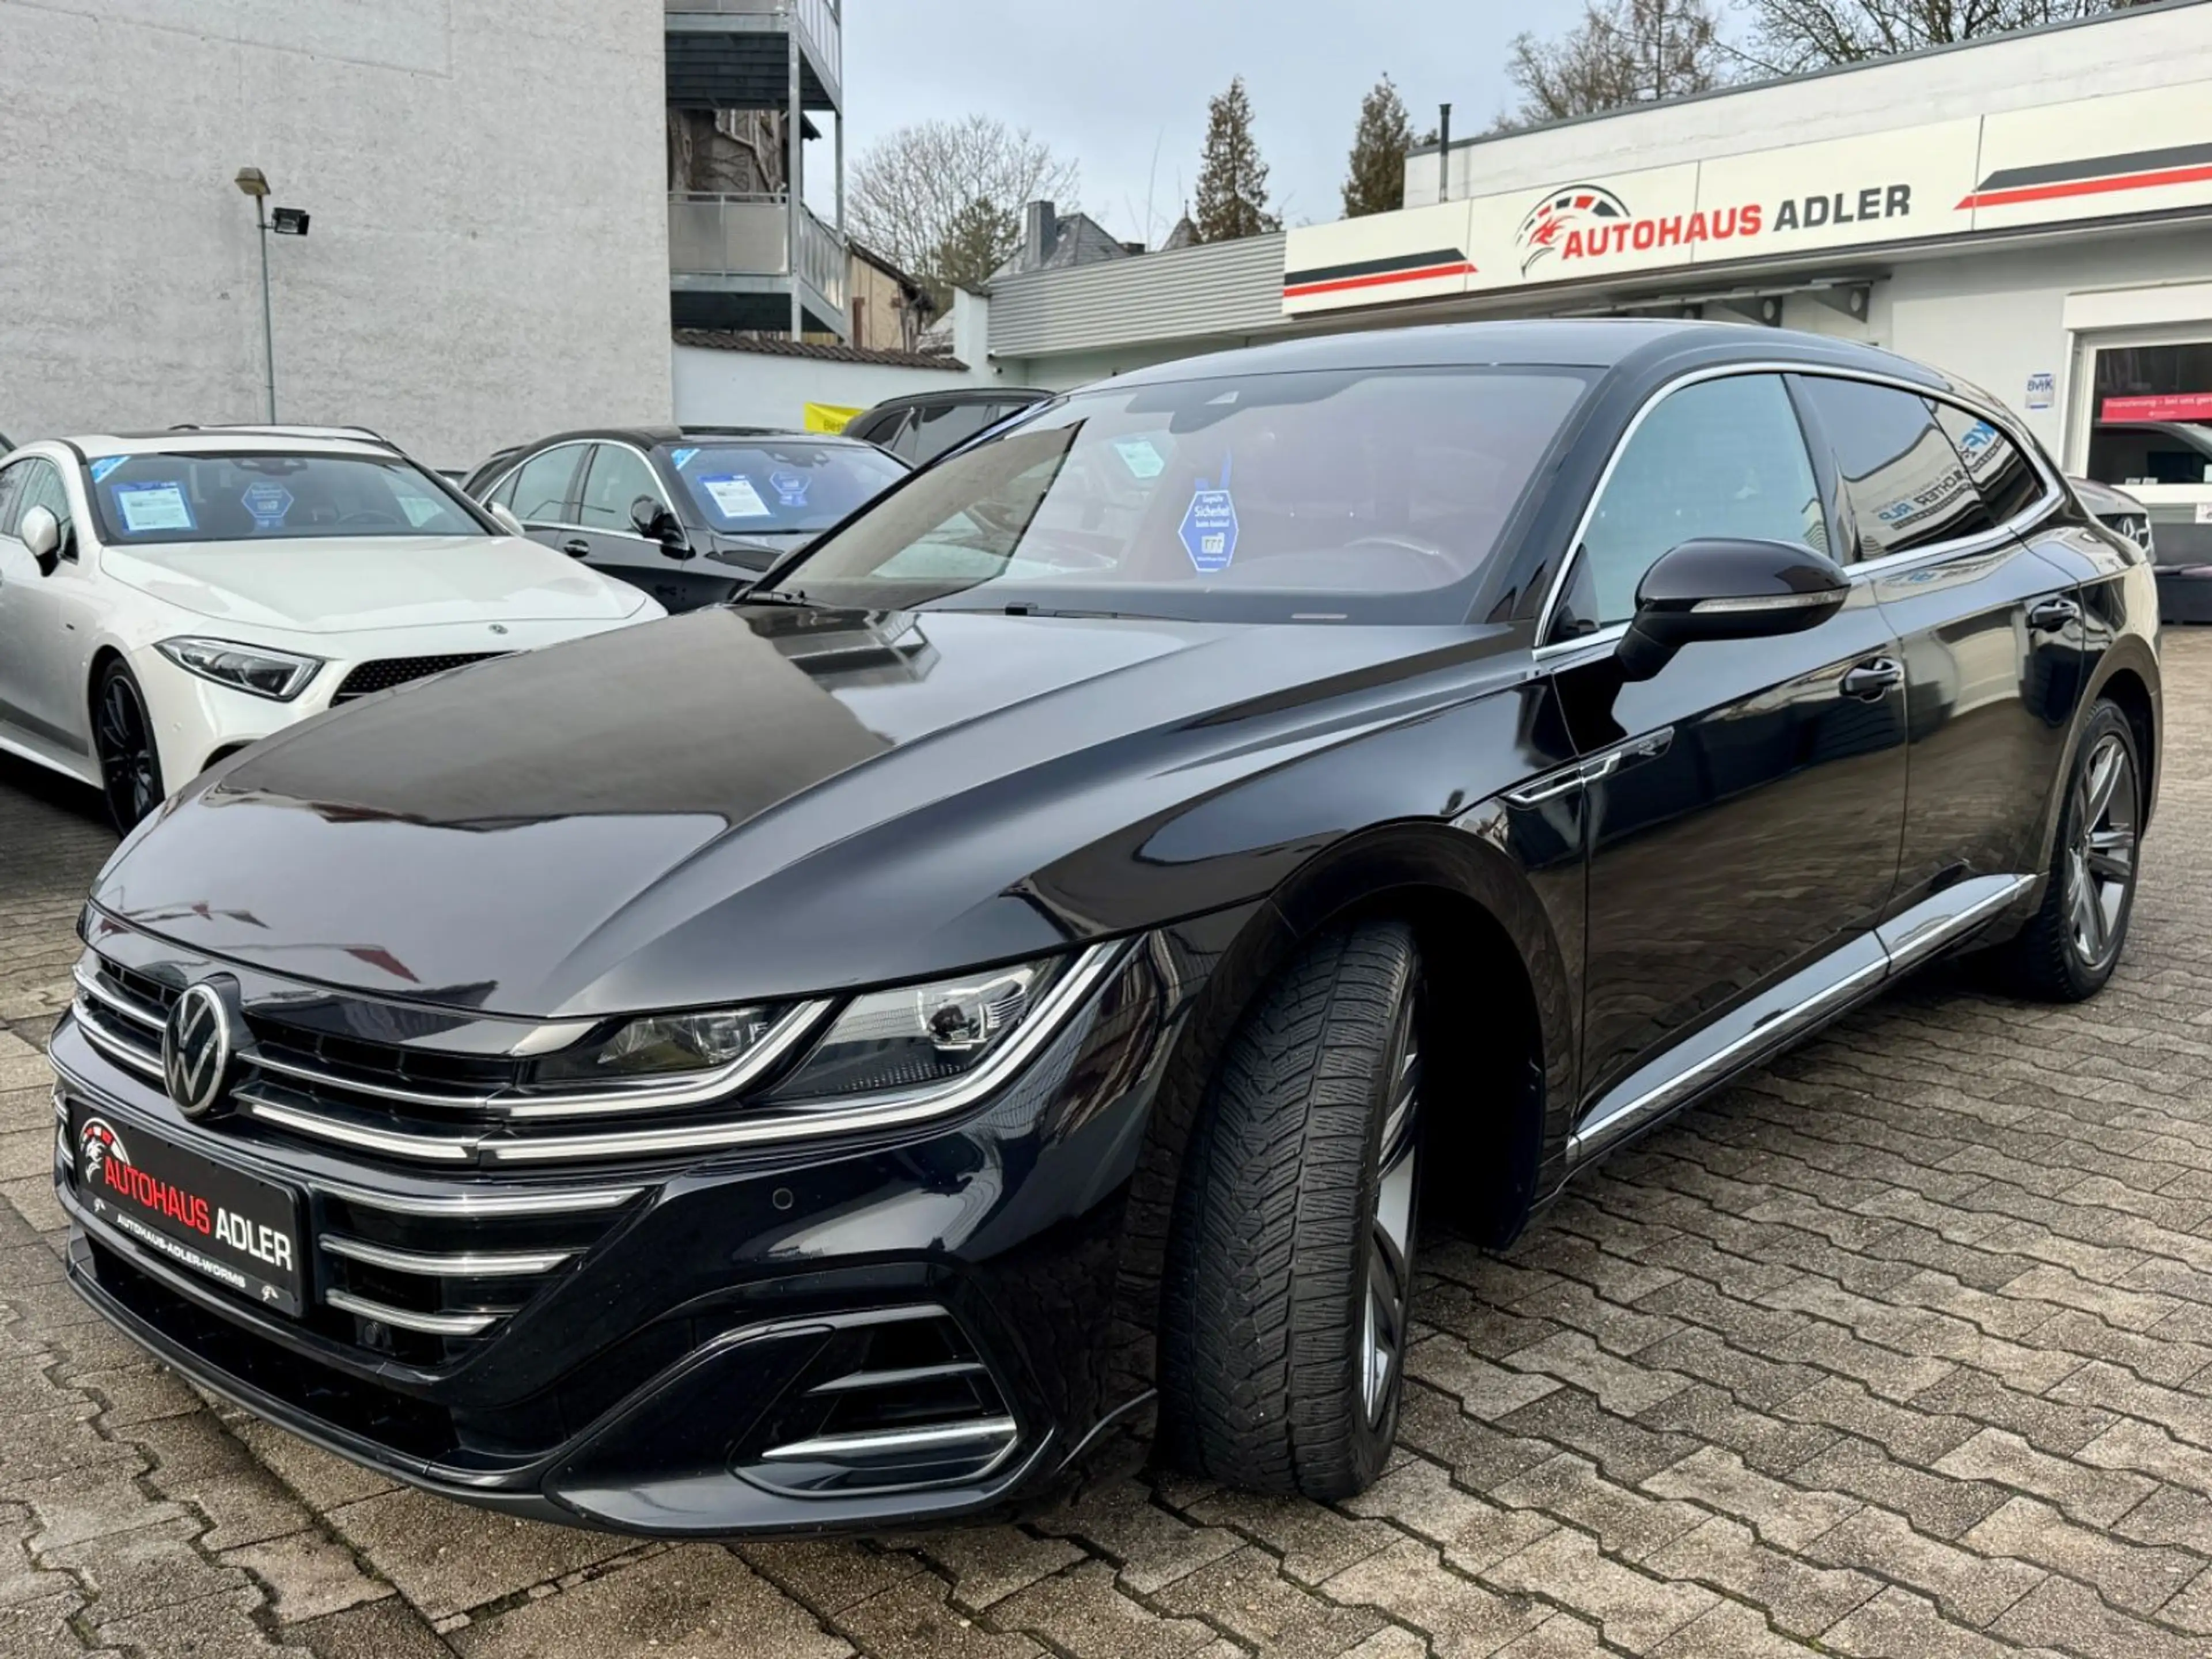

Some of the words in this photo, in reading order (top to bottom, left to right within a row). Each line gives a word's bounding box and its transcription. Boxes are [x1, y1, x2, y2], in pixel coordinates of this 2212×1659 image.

[1563, 204, 1761, 258] AUTOHAUS
[1774, 184, 1910, 232] ADLER
[104, 1157, 211, 1235] AUTOHAUS
[215, 1207, 293, 1271] ADLER
[116, 1213, 247, 1289] AUTOHAUS-ADLER-WORMS
